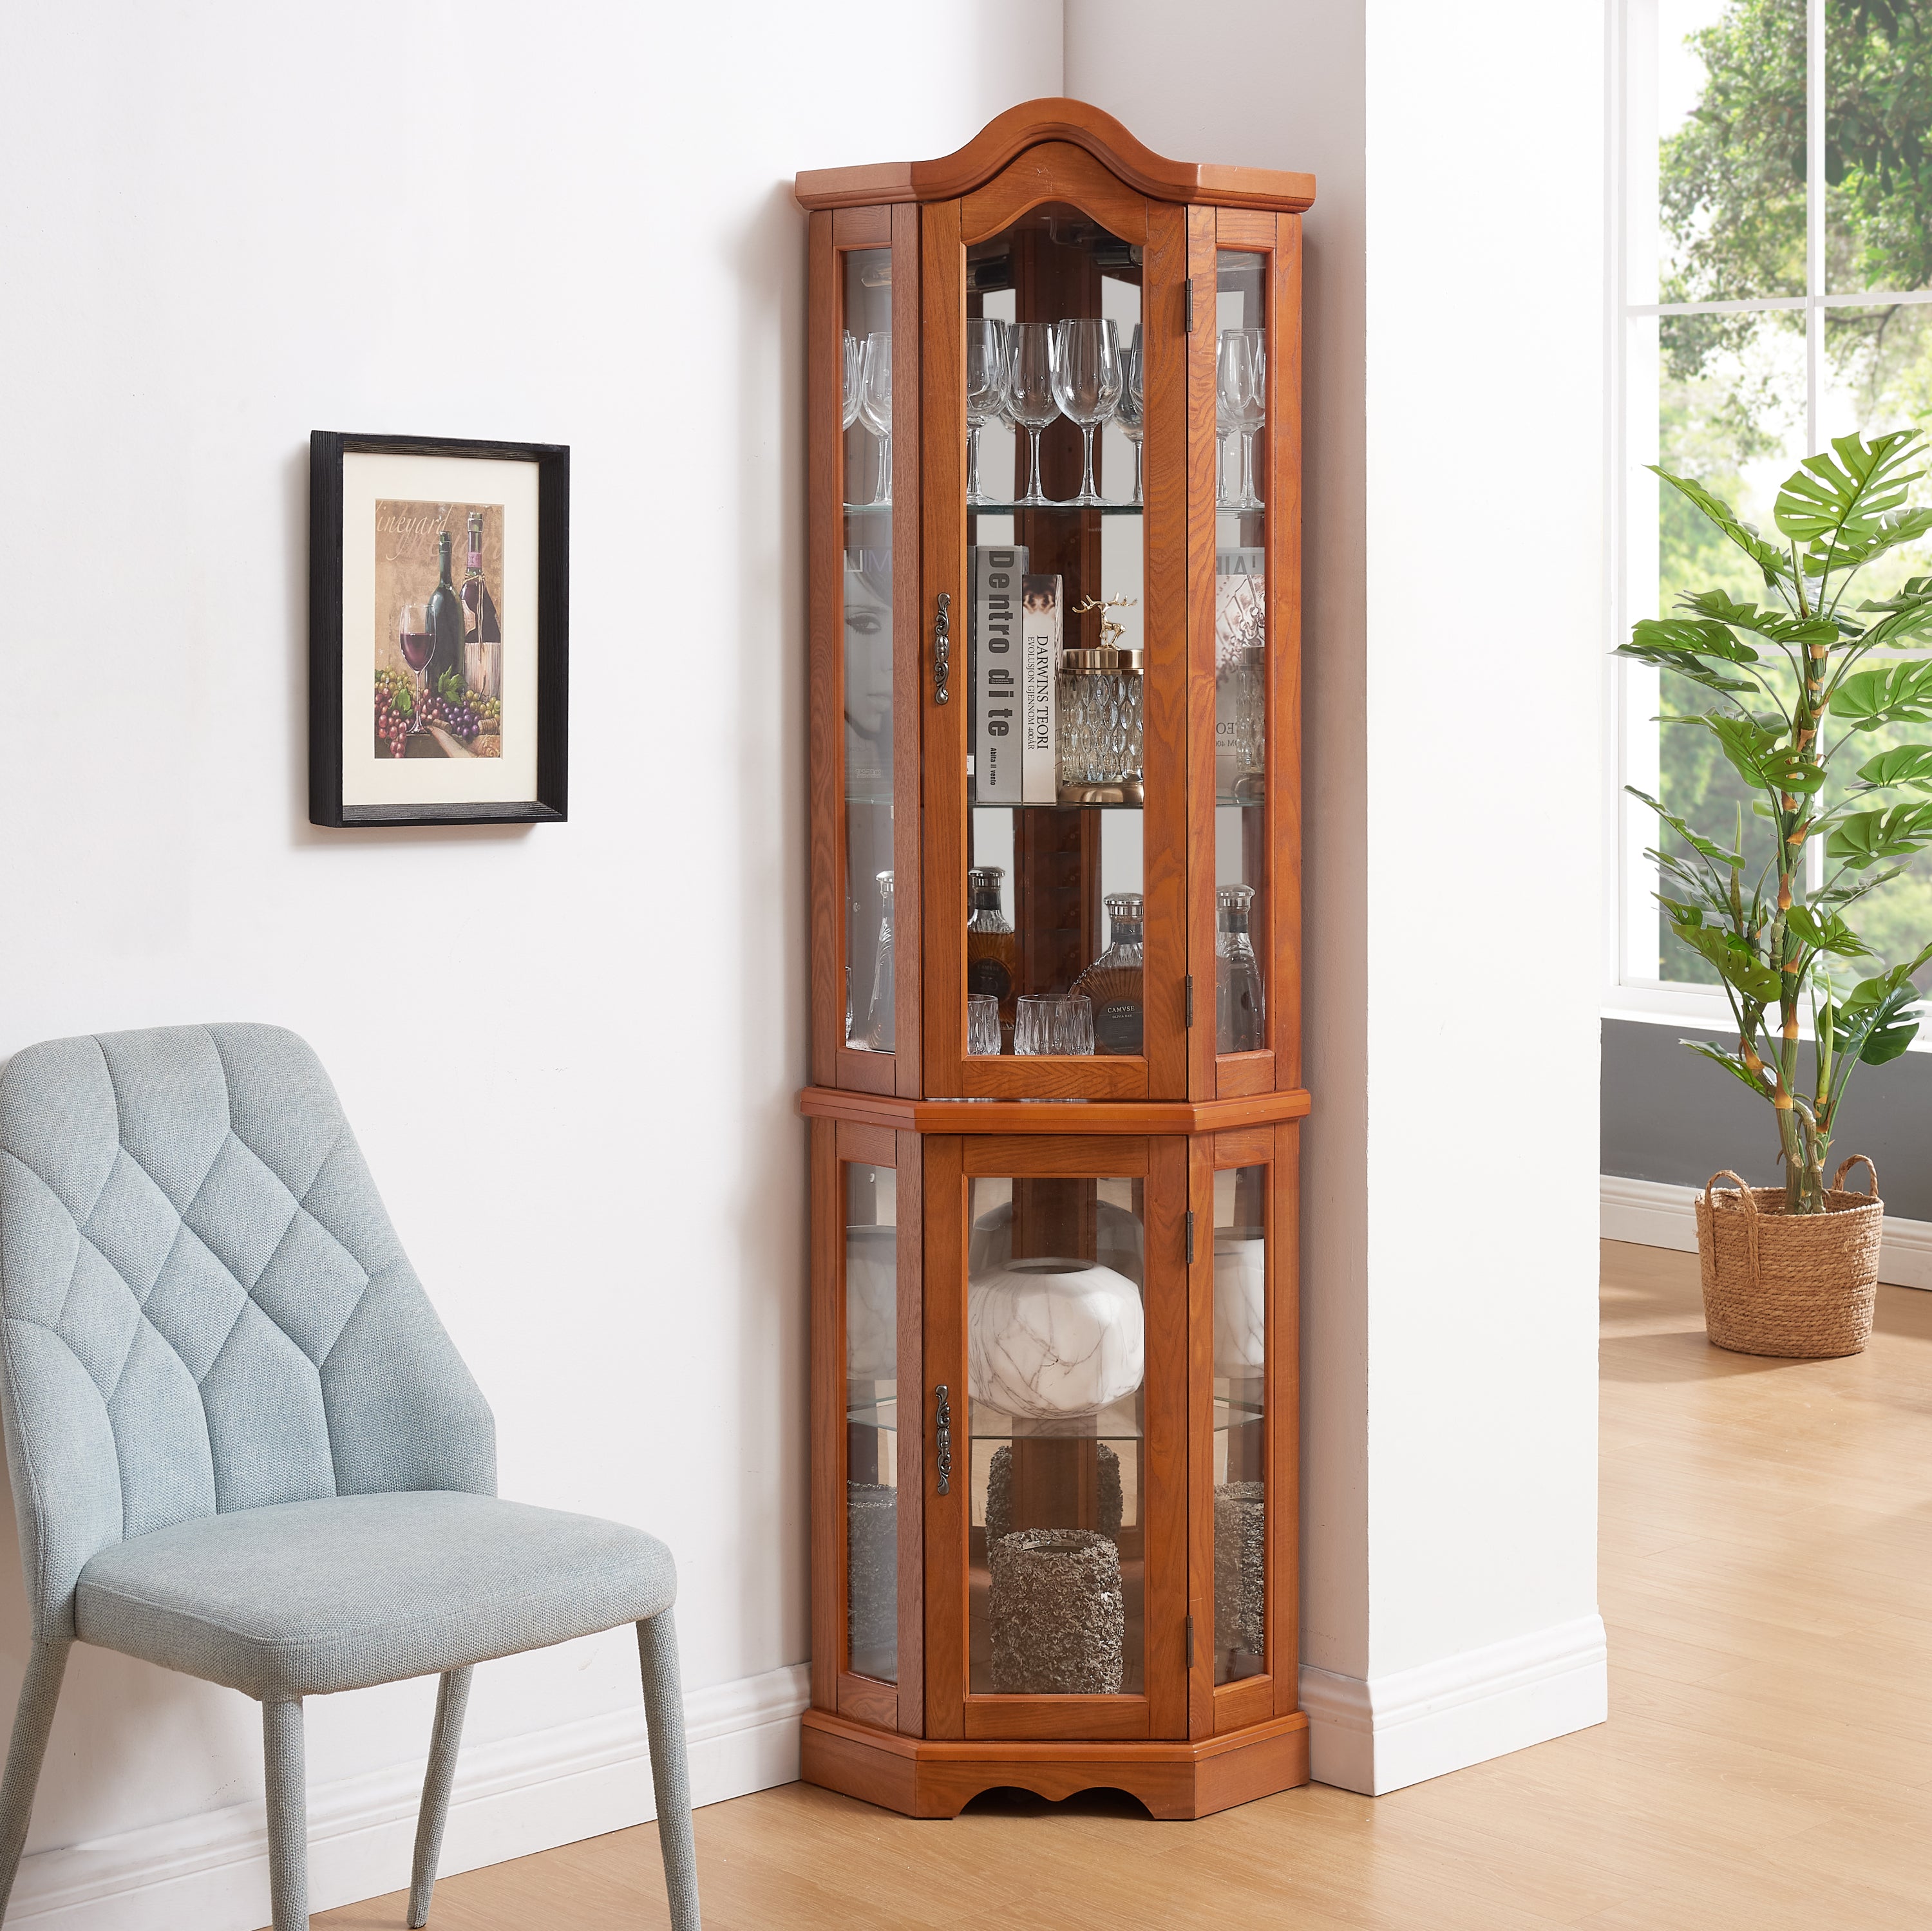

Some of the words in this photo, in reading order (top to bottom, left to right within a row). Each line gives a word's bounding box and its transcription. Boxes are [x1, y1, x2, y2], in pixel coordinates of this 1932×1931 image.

[988, 551, 1015, 654] Dentro
[1026, 636, 1035, 683] EVOLUSJON
[1037, 635, 1048, 702] DARWINS
[988, 669, 1014, 697] di
[988, 708, 1013, 736] te
[1026, 685, 1035, 725] GJENNOM
[1037, 706, 1048, 749] TEORI
[1107, 1005, 1135, 1013] CAMVSE
